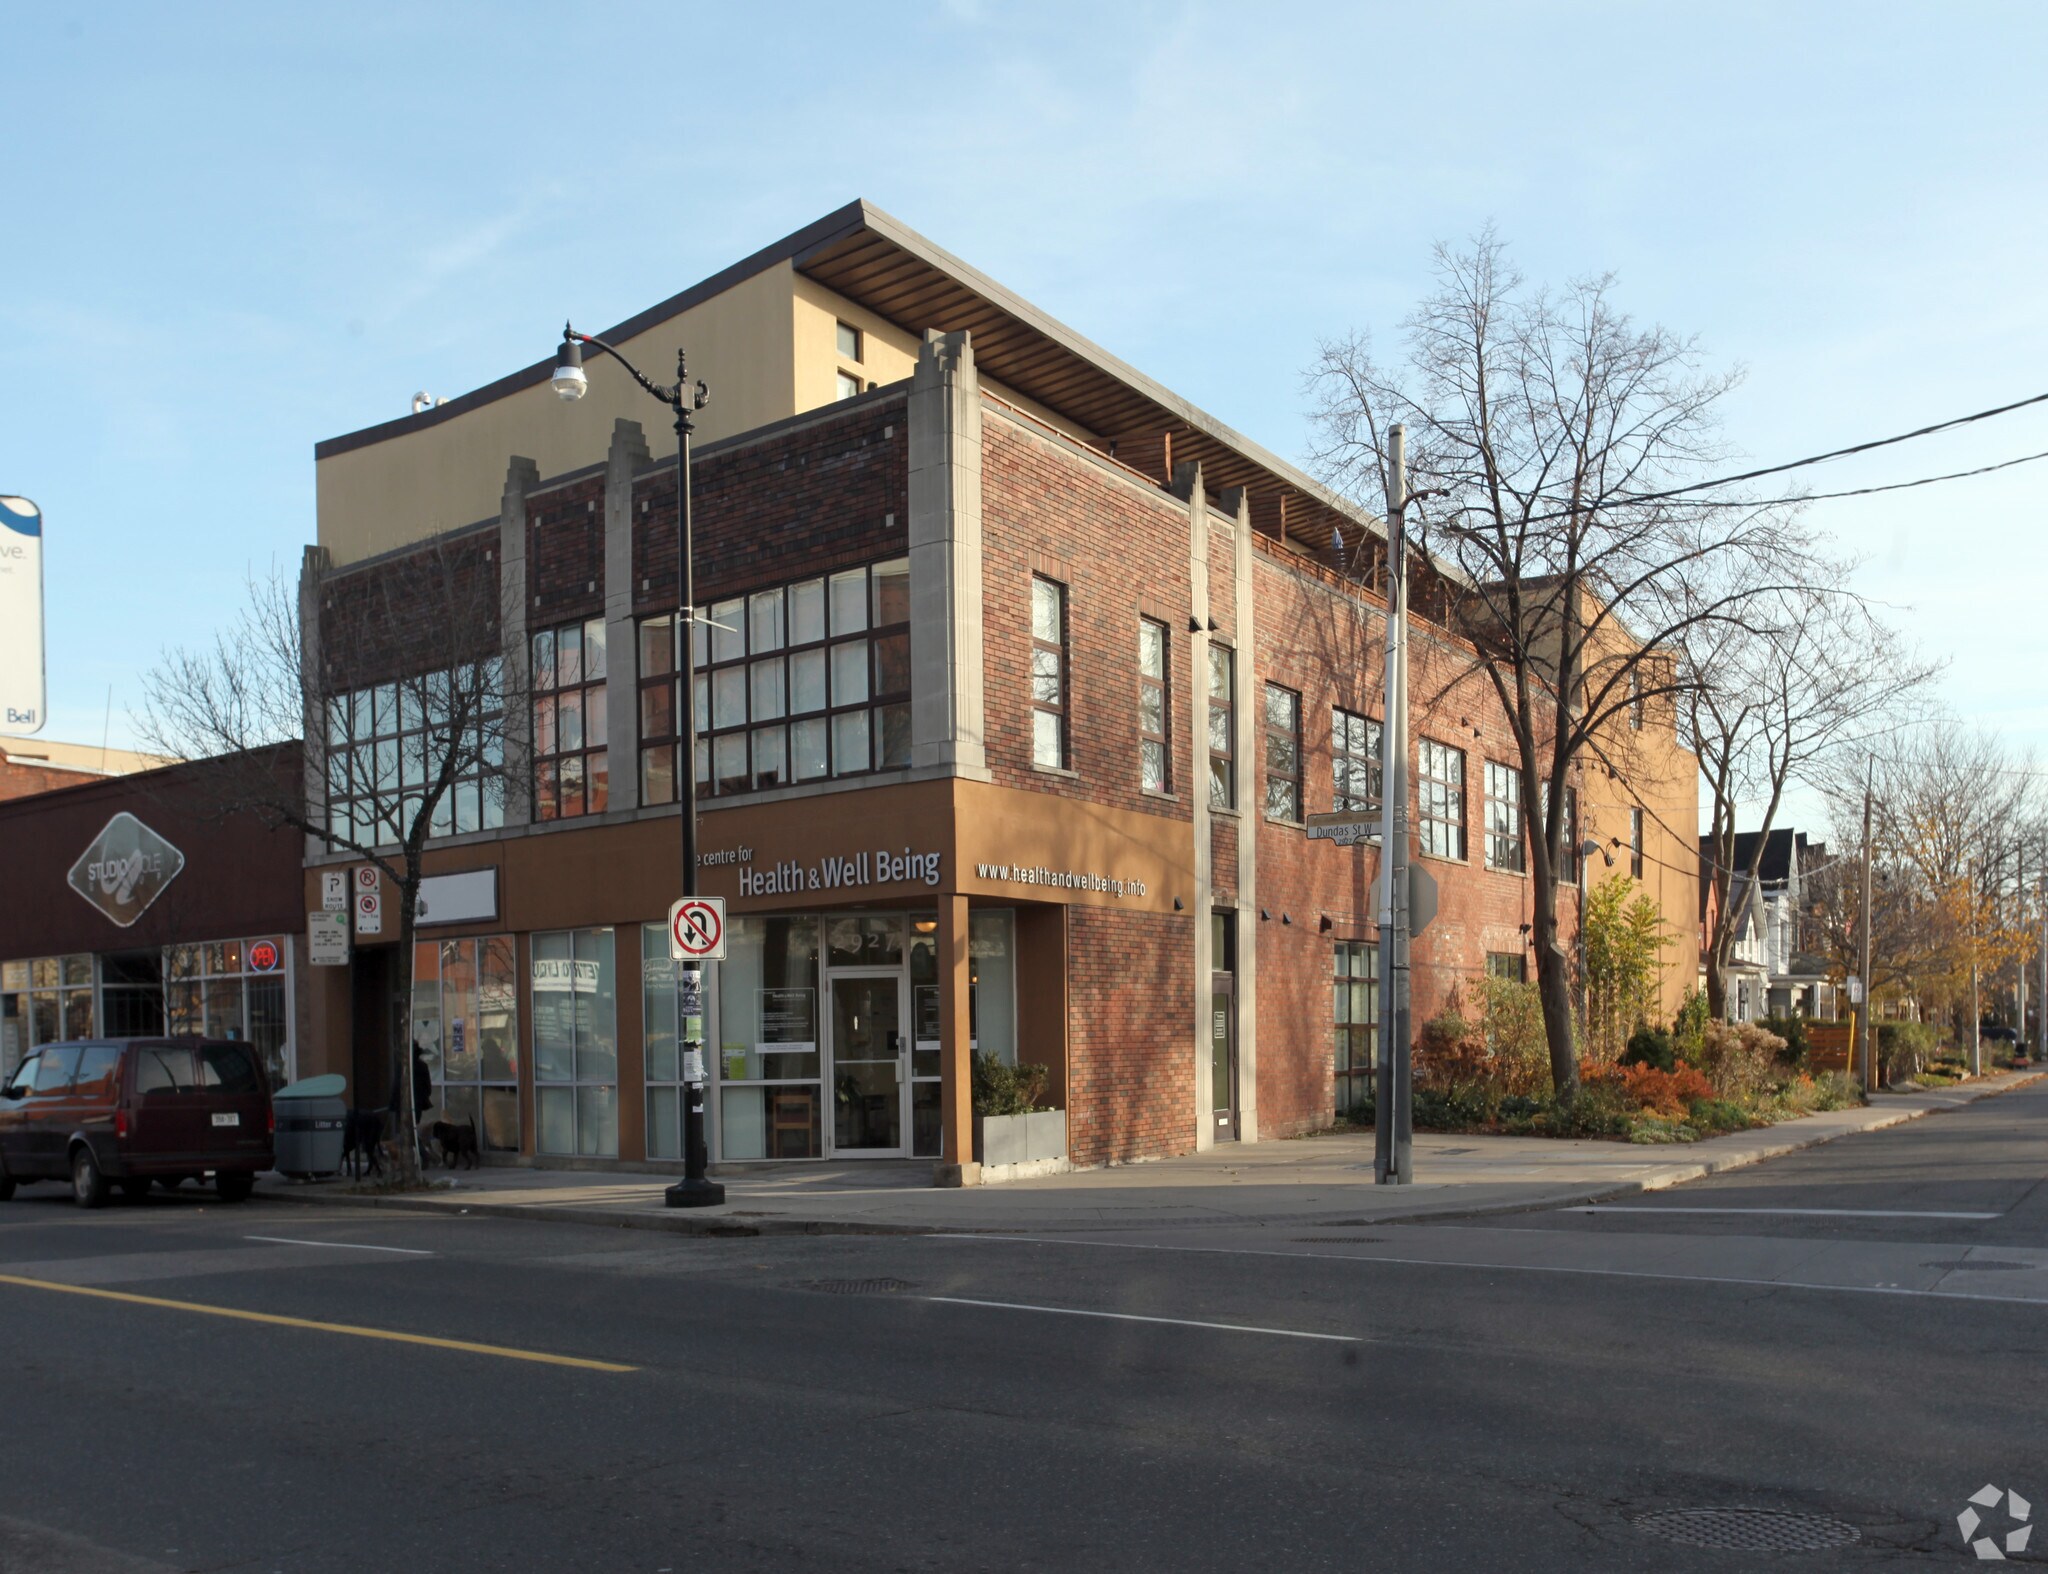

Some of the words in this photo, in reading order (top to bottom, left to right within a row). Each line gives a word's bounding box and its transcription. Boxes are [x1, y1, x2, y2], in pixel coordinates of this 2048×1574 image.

[7, 708, 35, 724] Bell
[1316, 826, 1349, 838] Dundas
[1352, 824, 1361, 835] St
[1364, 823, 1372, 834] W
[703, 848, 736, 866] centre
[738, 845, 754, 862] for
[88, 858, 129, 881] STUDIO
[739, 860, 804, 897] Health
[808, 867, 820, 890] &
[821, 851, 870, 889] Well
[876, 846, 941, 886] Being
[977, 863, 1146, 898] www.healthandwellbeing.info
[252, 947, 275, 966] OPEN
[315, 1120, 332, 1128] Litter
